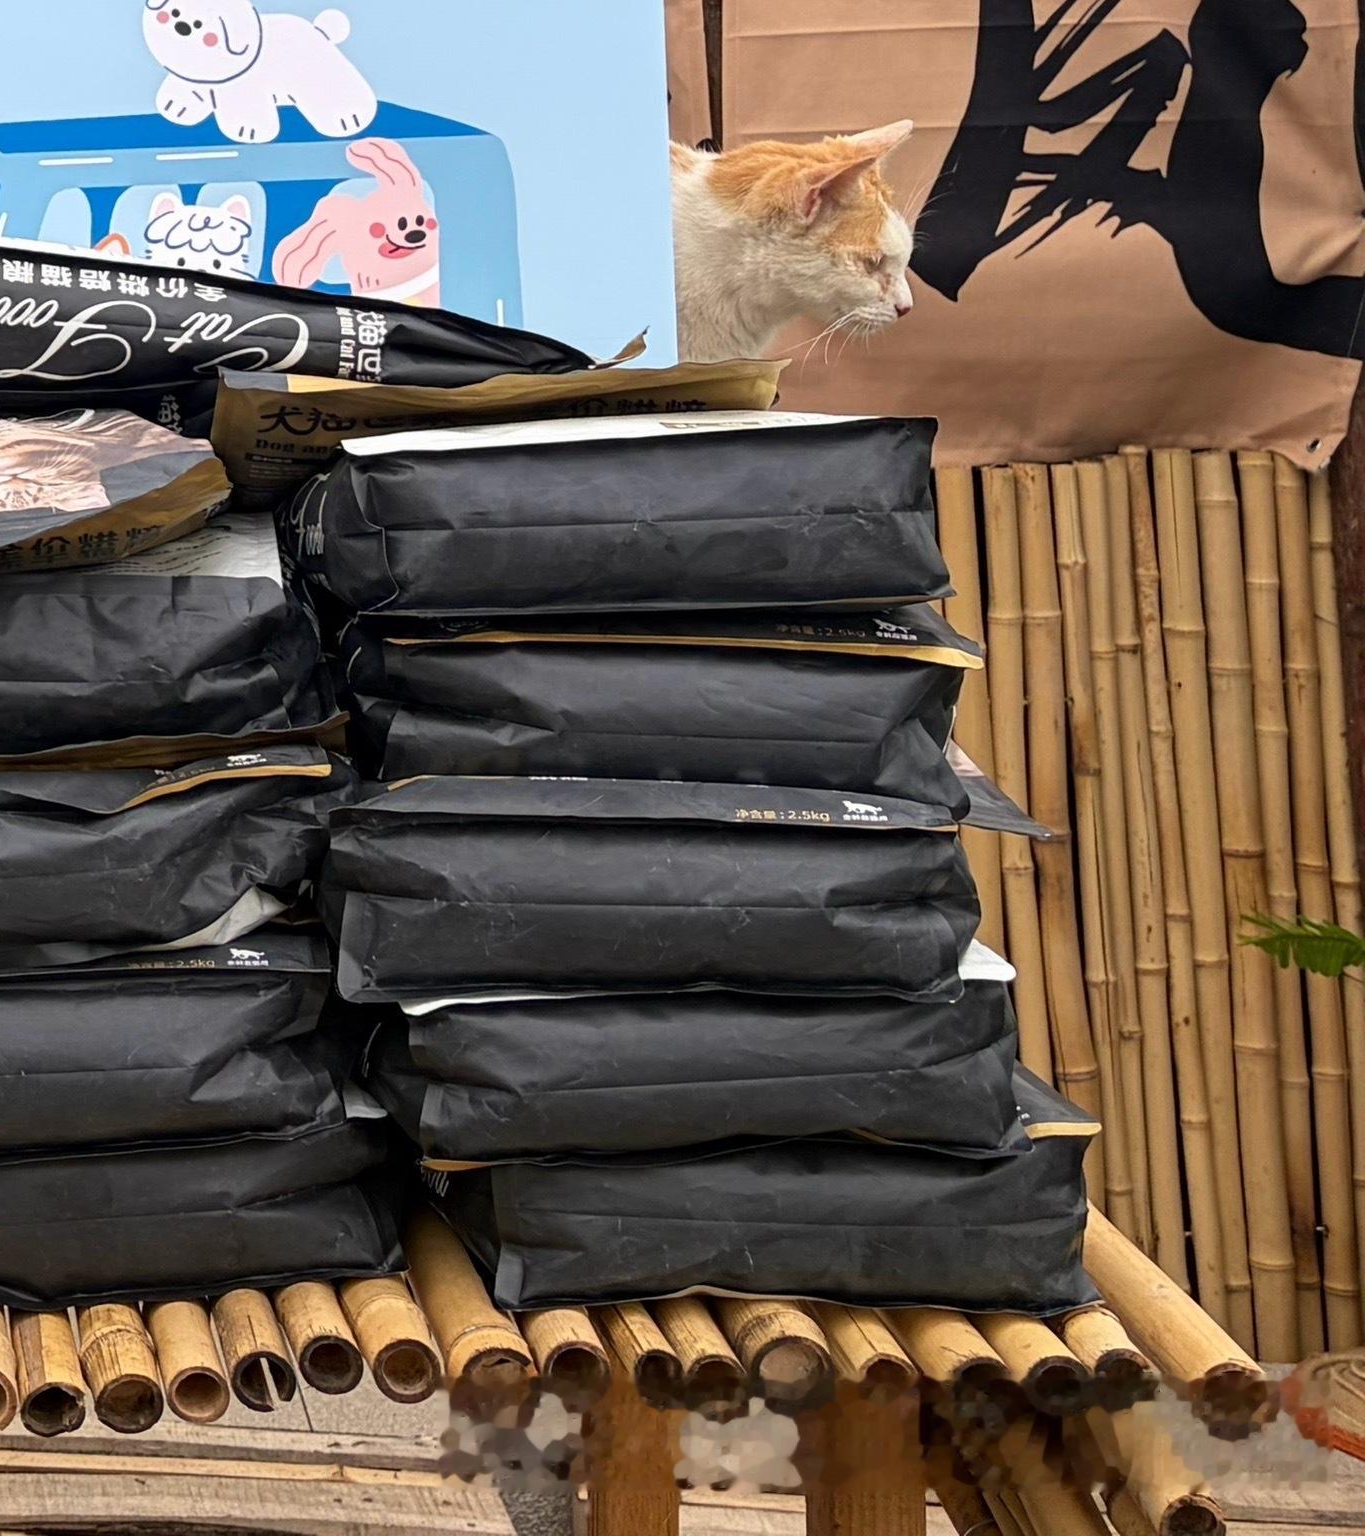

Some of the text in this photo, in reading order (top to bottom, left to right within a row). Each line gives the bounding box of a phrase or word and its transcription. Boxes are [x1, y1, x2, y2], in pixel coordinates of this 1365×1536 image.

[0, 257, 228, 303] 全价烘焙猫粮
[162, 309, 310, 377] Cat
[734, 808, 831, 822] 净含量：2.5kg
